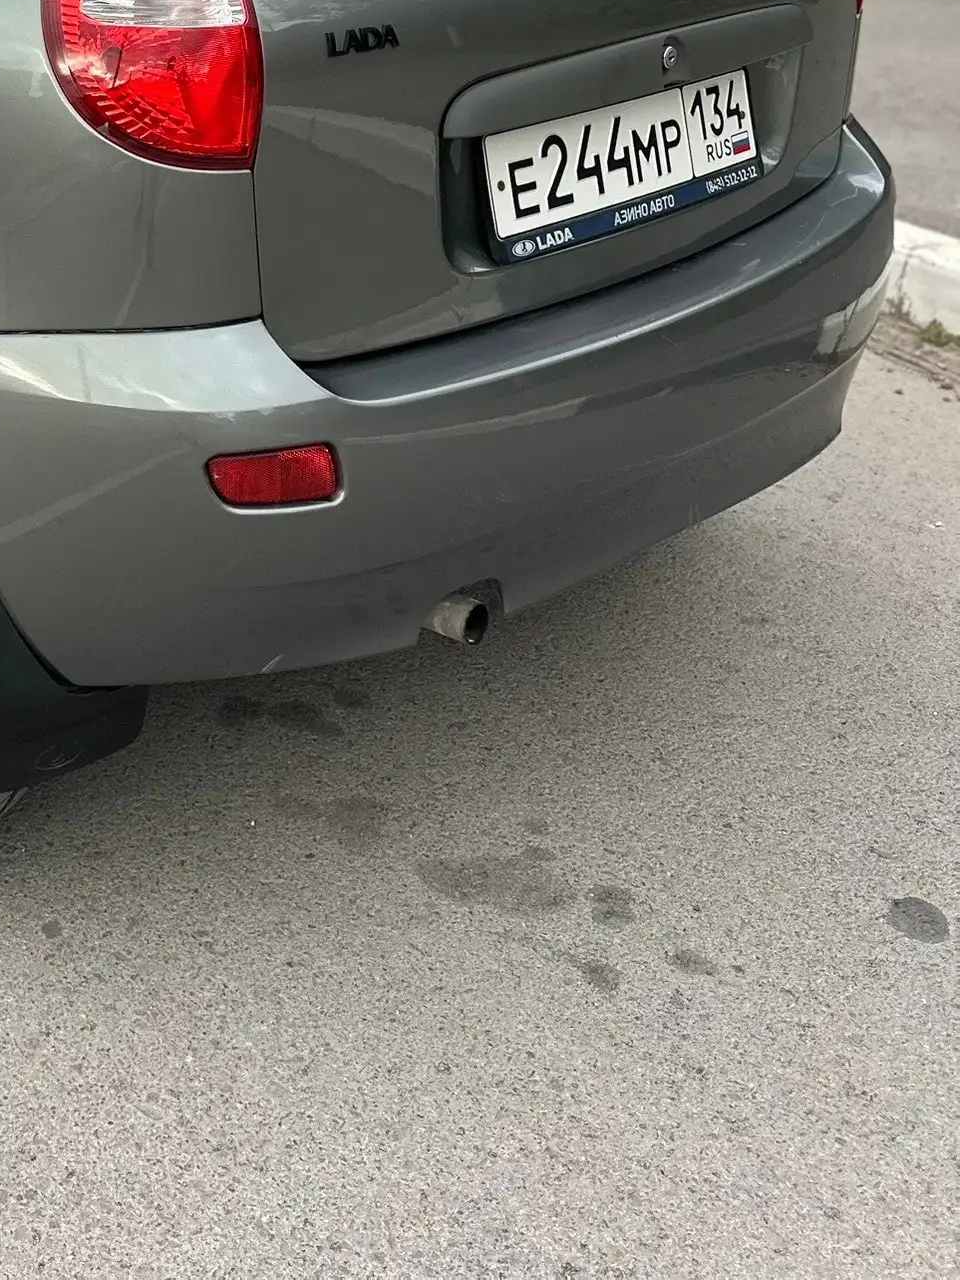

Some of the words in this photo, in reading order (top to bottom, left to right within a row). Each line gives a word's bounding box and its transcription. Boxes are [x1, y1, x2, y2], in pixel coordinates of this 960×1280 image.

[325, 24, 400, 57] LADA
[690, 80, 743, 140] 134
[706, 138, 732, 163] RUS
[614, 204, 649, 226] АЗИНО
[649, 194, 675, 215] АВТО
[536, 227, 575, 251] LADA
